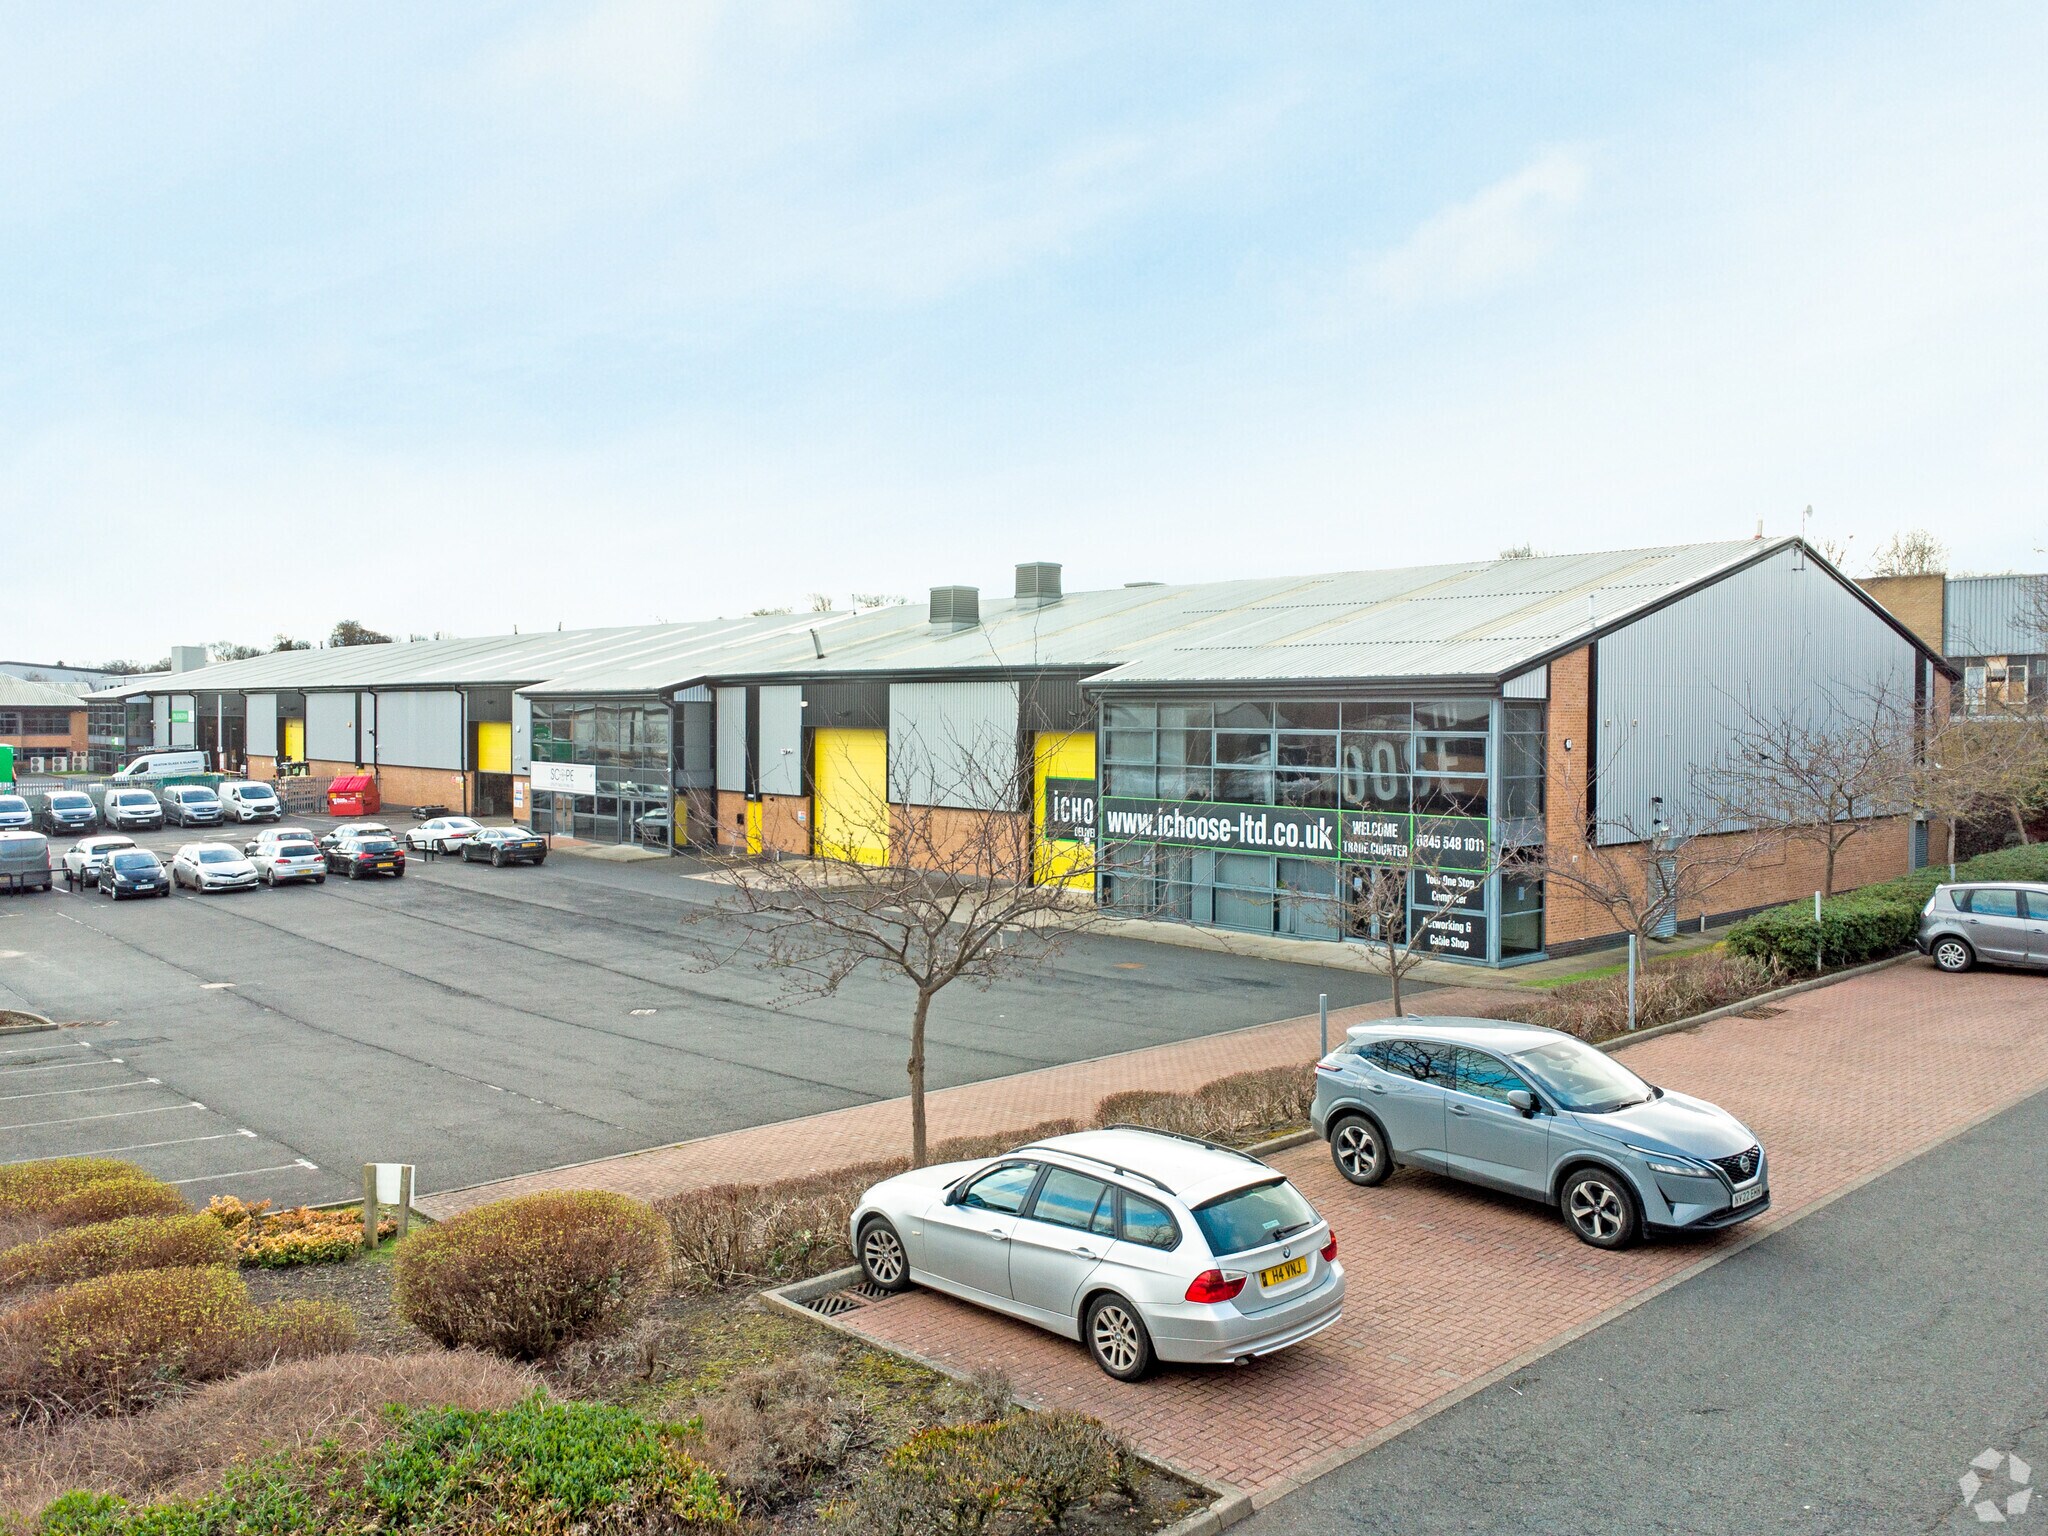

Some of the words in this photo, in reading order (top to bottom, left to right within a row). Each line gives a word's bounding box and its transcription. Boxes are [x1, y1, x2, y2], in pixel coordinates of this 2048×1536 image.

[1107, 807, 1333, 850] www.ichoose-ltd.co.uk
[1352, 821, 1398, 838] WELCOME
[1342, 840, 1369, 854] TRADE
[1370, 842, 1408, 858] COUNTER
[1443, 836, 1462, 850] 548
[1464, 837, 1484, 852] 1011
[1442, 875, 1457, 887] One
[1465, 921, 1472, 933] &
[1450, 936, 1470, 951] Shop
[1272, 1268, 1284, 1282] H4
[1285, 1261, 1302, 1277] VNJ
